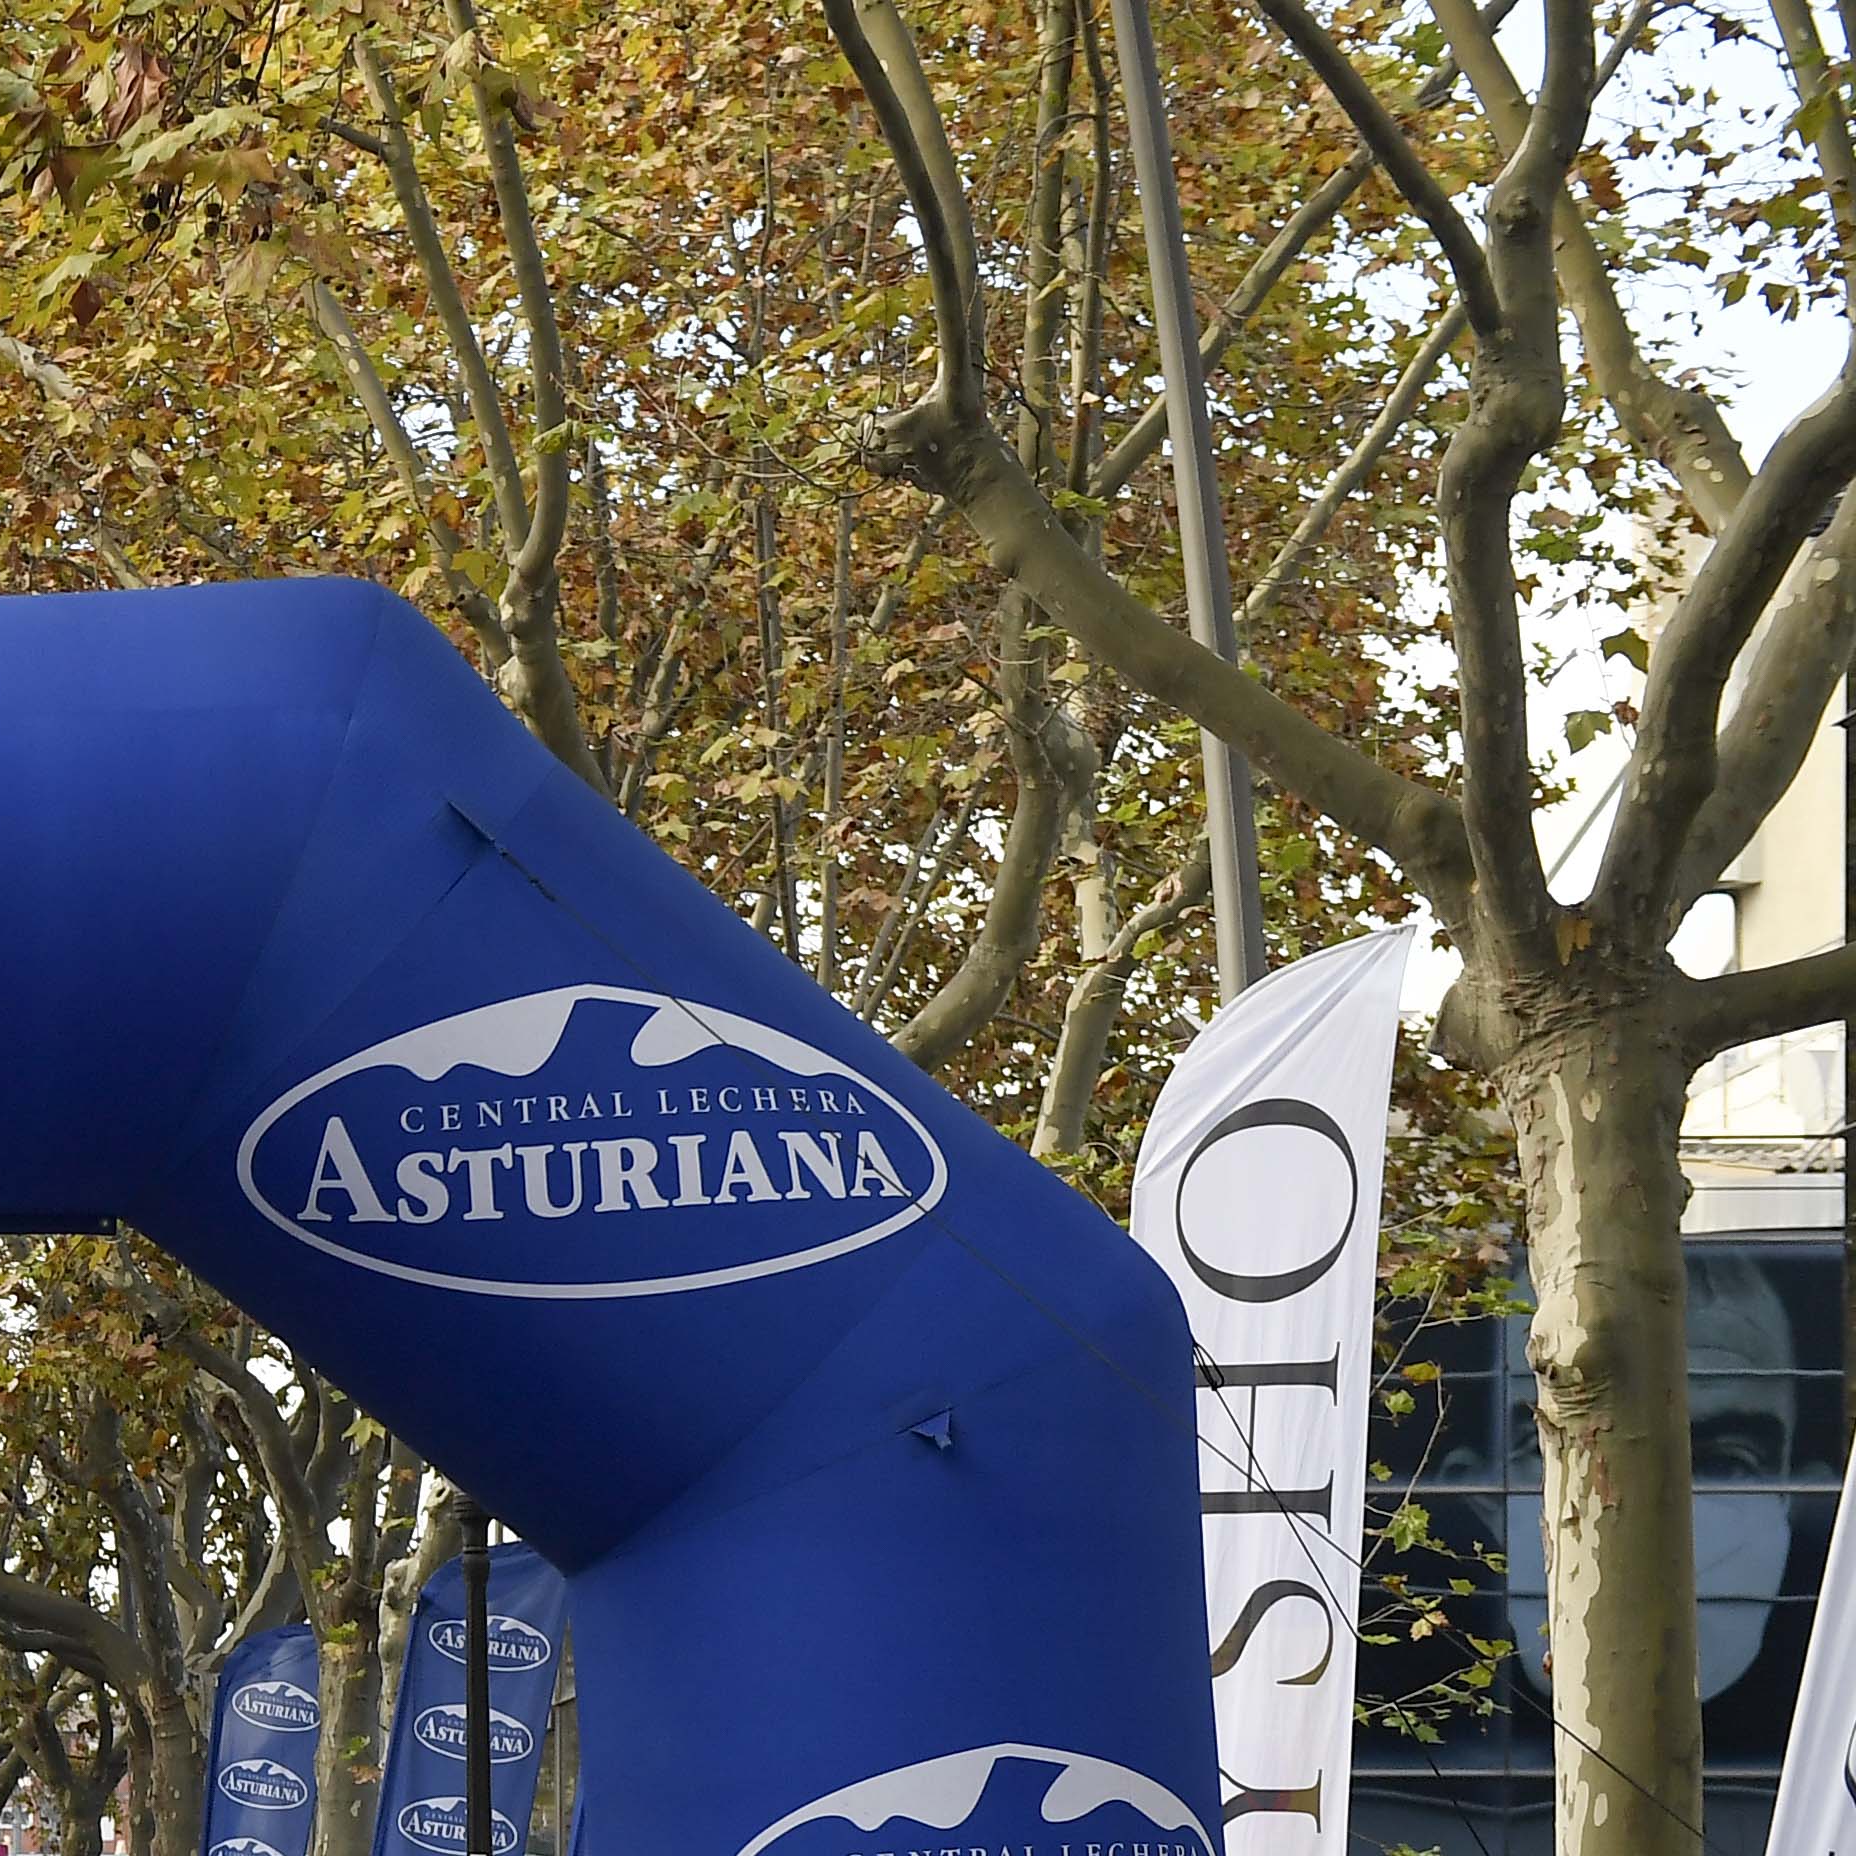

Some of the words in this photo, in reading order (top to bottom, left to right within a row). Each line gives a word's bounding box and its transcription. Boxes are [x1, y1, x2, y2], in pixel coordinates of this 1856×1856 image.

[400, 1091, 633, 1135] CENTRAL
[657, 1086, 867, 1117] LECHERA
[296, 1115, 913, 1226] ASTURIANA
[238, 1692, 315, 1725] ASTURIANA
[225, 1771, 300, 1803] ASTURIANA
